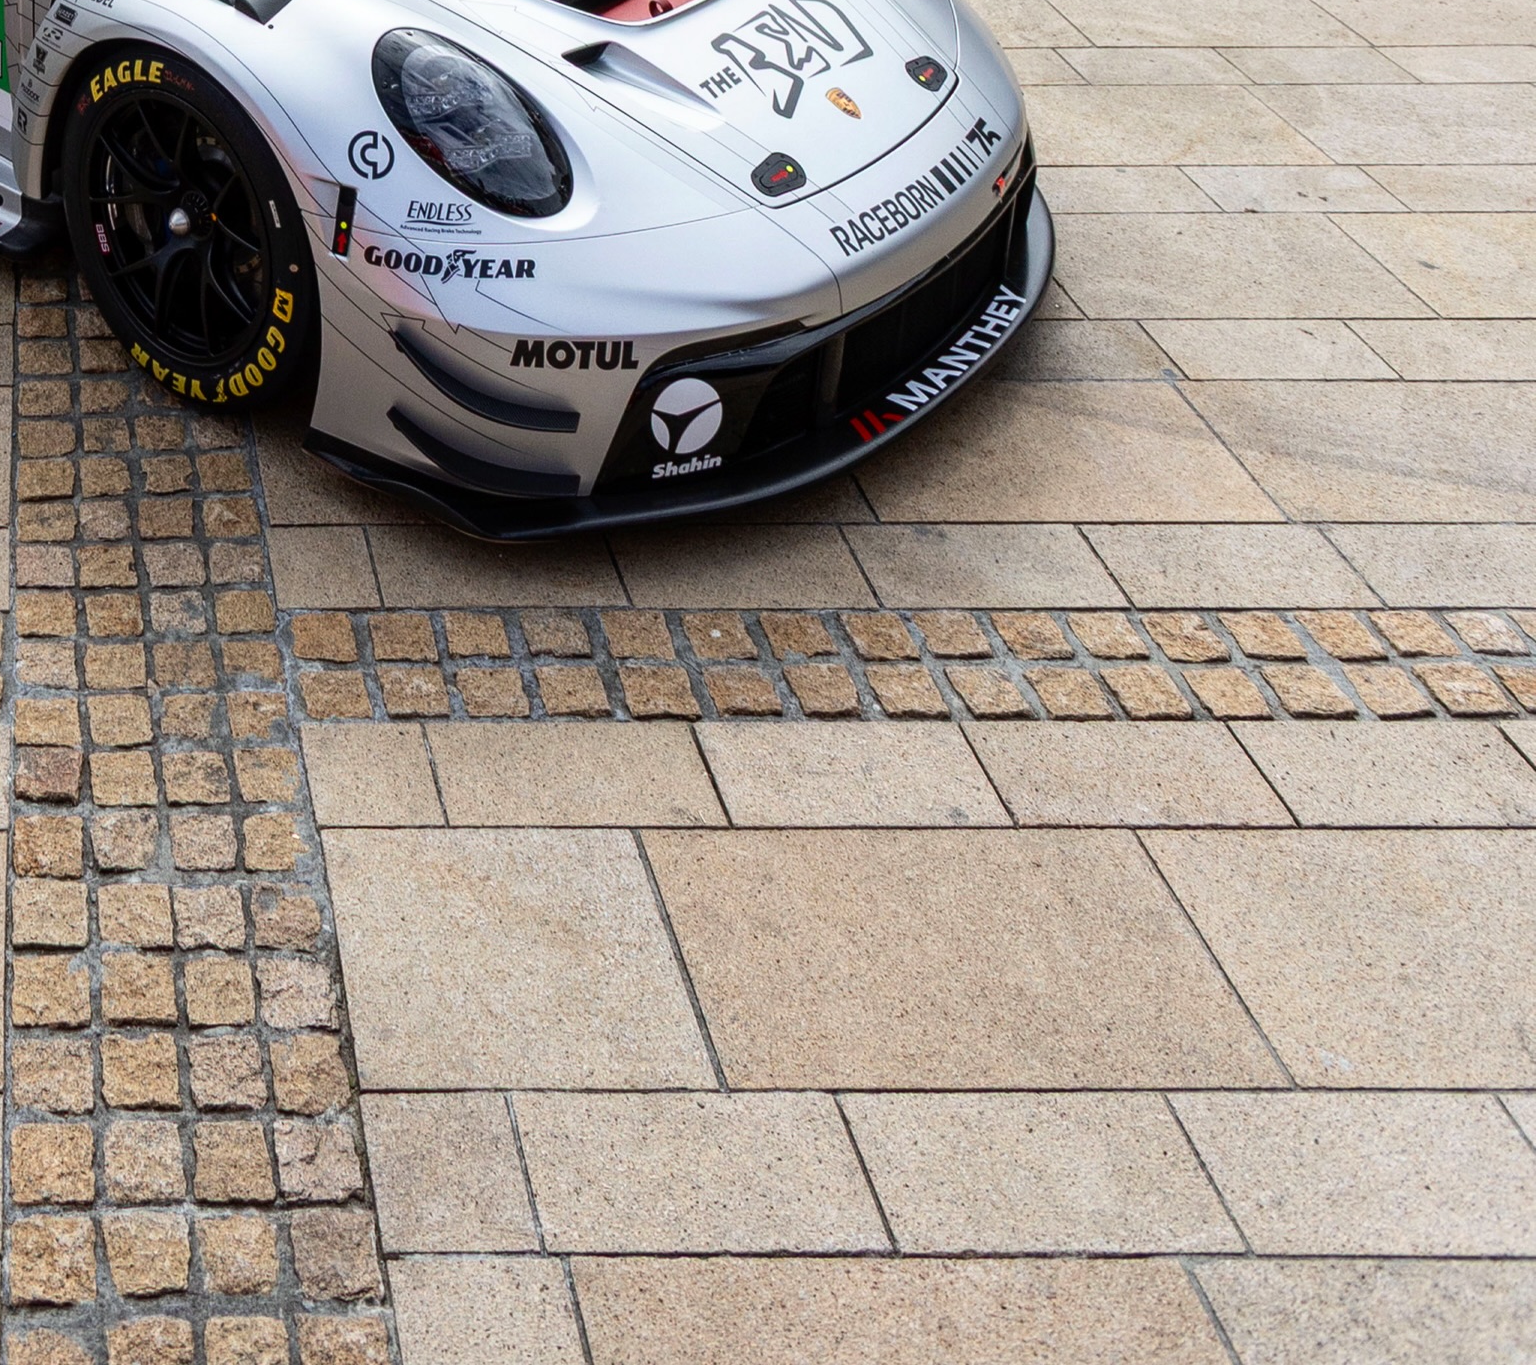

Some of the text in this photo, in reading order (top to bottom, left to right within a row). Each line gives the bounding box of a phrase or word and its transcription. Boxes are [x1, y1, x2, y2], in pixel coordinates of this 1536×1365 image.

[90, 59, 164, 103] EAGLE
[699, 65, 742, 100] THE
[829, 116, 1002, 257] RACEBORN 75
[407, 200, 472, 222] ENDLESS
[94, 223, 110, 254] BBS
[400, 224, 424, 233] Advanced
[424, 226, 441, 235] Racing
[364, 245, 536, 283] GOODYEAR
[510, 339, 639, 369] MOTUL
[886, 285, 1026, 411] MANTHEY
[131, 329, 287, 403] GOODYEAR
[652, 454, 722, 479] Shahin
